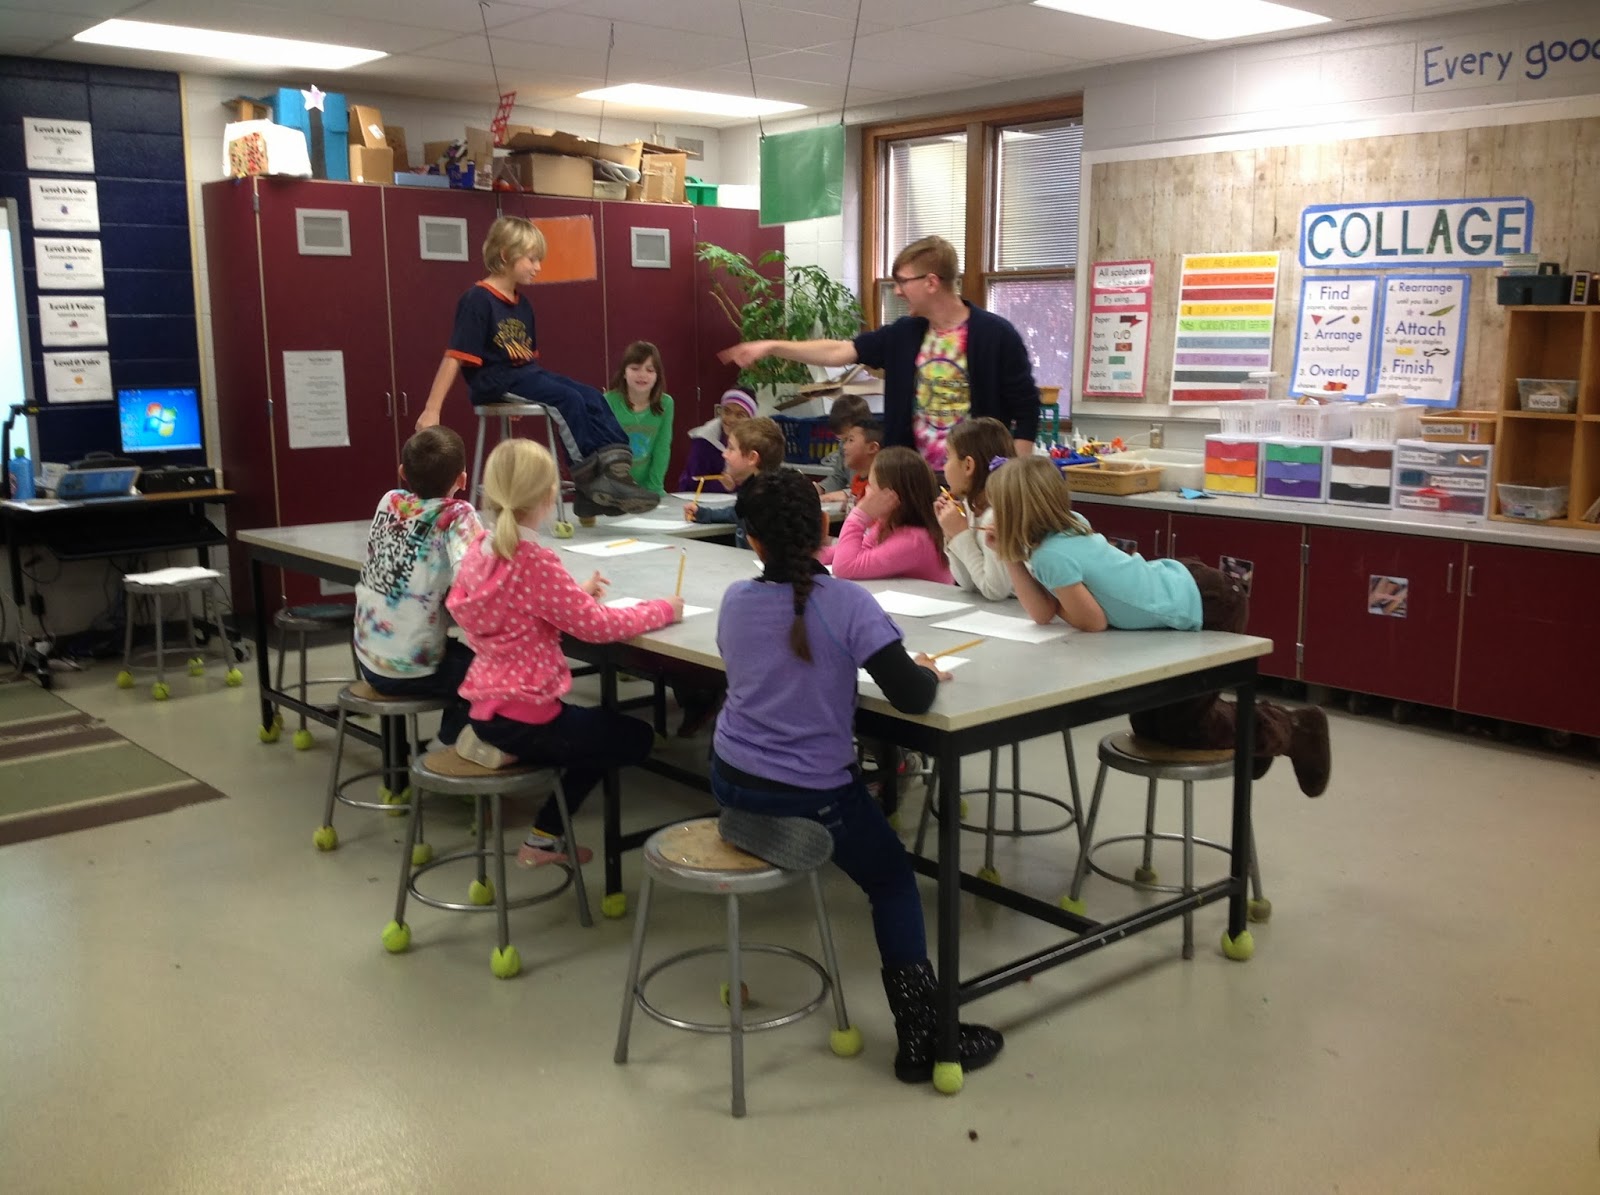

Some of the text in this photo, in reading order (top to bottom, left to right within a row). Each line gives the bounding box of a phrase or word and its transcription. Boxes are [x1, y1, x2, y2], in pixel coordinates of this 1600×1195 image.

[1424, 46, 1512, 86] Every
[33, 125, 54, 133] Level
[61, 127, 82, 135] Voice
[39, 185, 60, 193] Level
[68, 187, 88, 195] Voice
[1307, 206, 1525, 260] COLLAGE
[44, 244, 65, 252] Level
[72, 246, 92, 254] Voice
[1099, 268, 1147, 278] All sculptures
[1320, 285, 1350, 300] Find
[1399, 282, 1453, 295] Rearrange
[1104, 296, 1112, 304] Try
[49, 303, 70, 311] Level
[1395, 321, 1446, 336] Attach
[1315, 329, 1362, 343] Arrange
[1317, 345, 1350, 353] background
[53, 359, 73, 367] Level
[82, 359, 101, 367] Voice
[1393, 359, 1434, 374] Finish
[1309, 364, 1360, 380] Overlap
[1531, 398, 1558, 407] Wood
[1425, 426, 1462, 434] Glue Sticks
